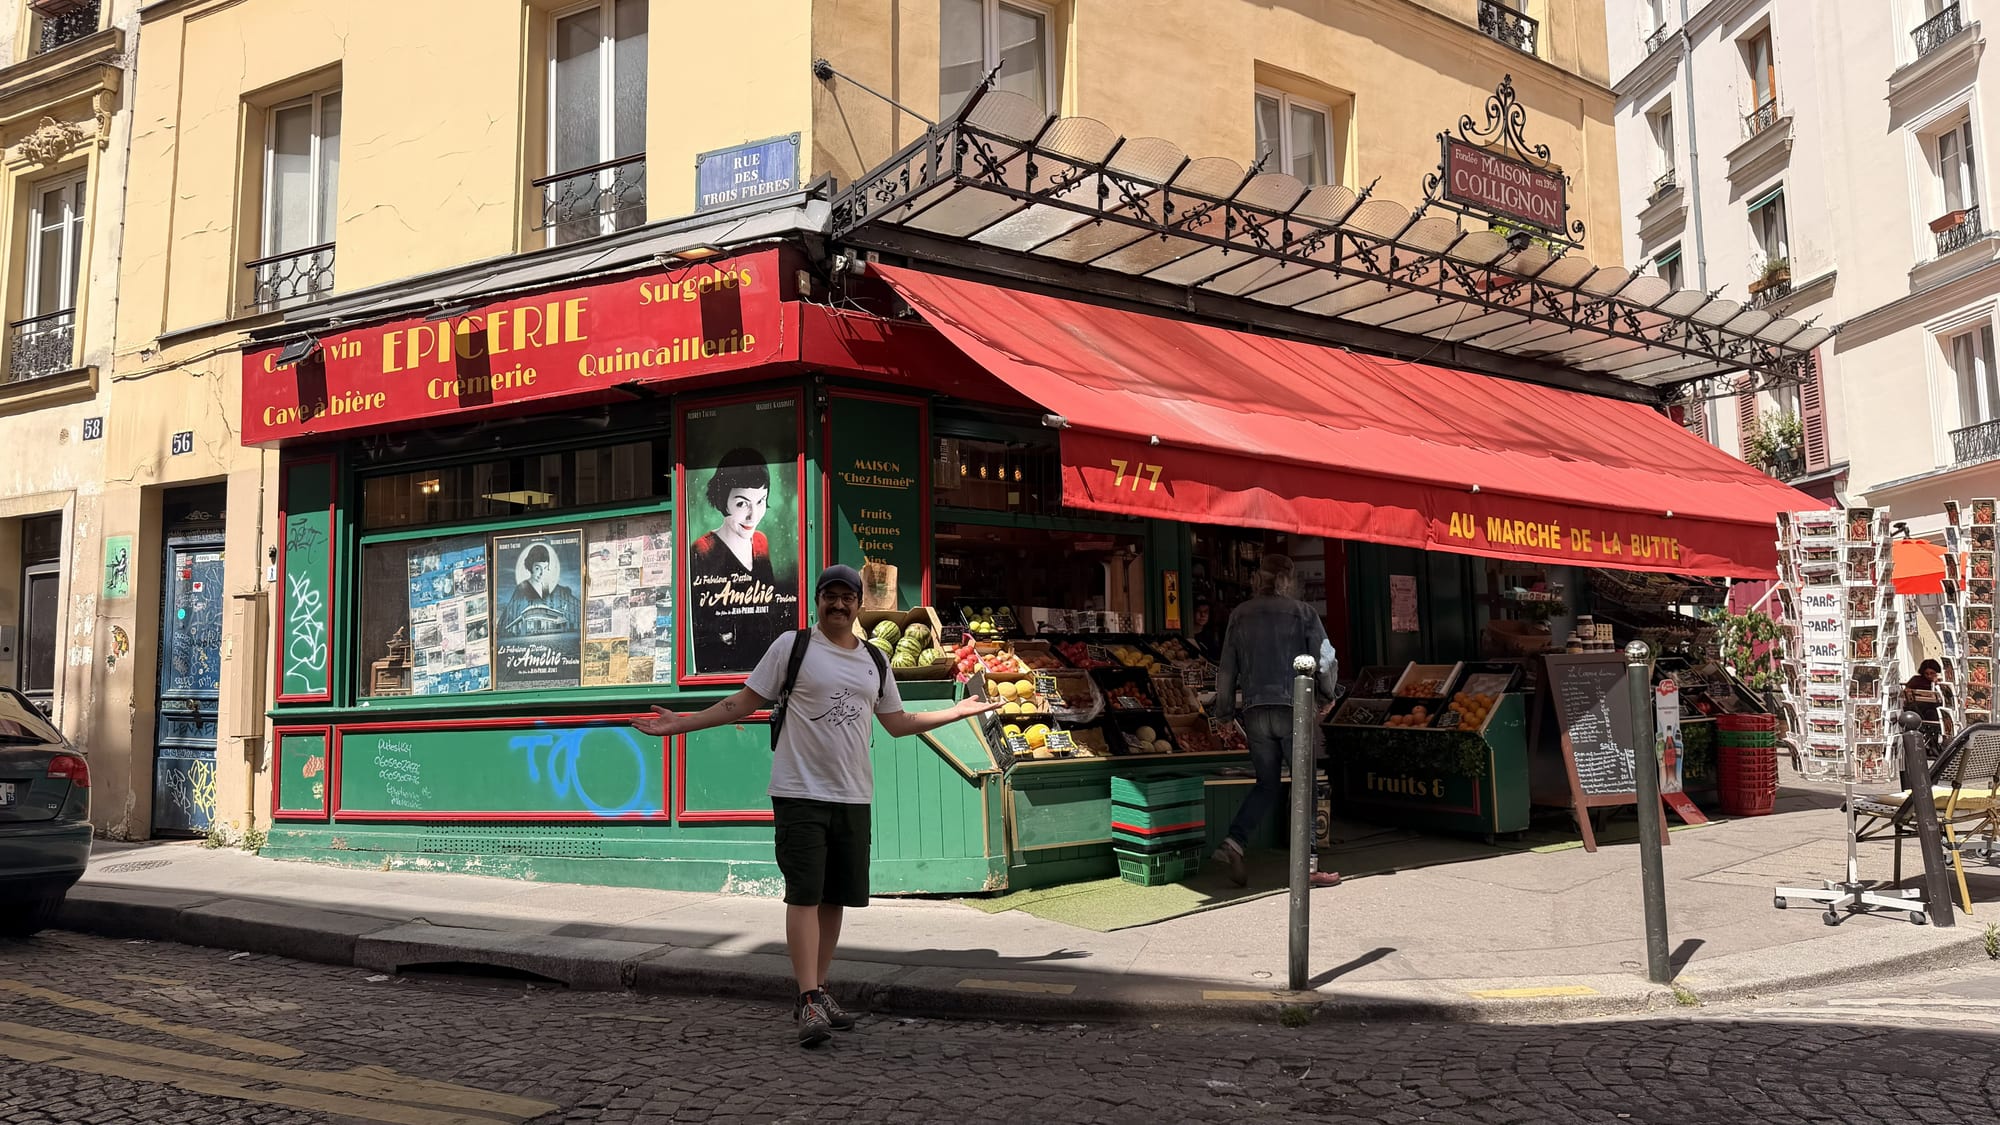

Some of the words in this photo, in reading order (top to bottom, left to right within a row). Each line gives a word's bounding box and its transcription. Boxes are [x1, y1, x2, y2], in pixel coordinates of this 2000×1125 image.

[733, 152, 760, 170] RUE
[1481, 157, 1531, 188] MAISON
[734, 169, 759, 185] DES
[703, 188, 738, 206] TROIS
[741, 178, 790, 199] FRÈRES
[1455, 169, 1557, 220] COLLIGNON
[639, 263, 752, 306] Surgelés
[330, 336, 362, 361] vin
[382, 296, 589, 374] EPICERIE
[577, 328, 756, 377] Quincaillerie
[427, 362, 537, 400] Crèmerie
[263, 403, 309, 427] Cave
[314, 397, 326, 418] à
[331, 390, 386, 416] bière
[84, 419, 100, 440] 58
[173, 432, 191, 454] 56
[854, 459, 900, 473] MAISON
[1110, 459, 1163, 492] 7/7
[860, 508, 892, 521] Fruits
[853, 523, 900, 537] Légumes
[1449, 511, 1475, 539] AU
[1487, 516, 1561, 550] MARCHÉ
[1570, 527, 1593, 553] DE
[1601, 530, 1622, 556] LA
[1631, 534, 1680, 560] BUTTE
[859, 537, 894, 552] Épices
[1367, 772, 1427, 796] Fruits
[1432, 778, 1445, 798] &
